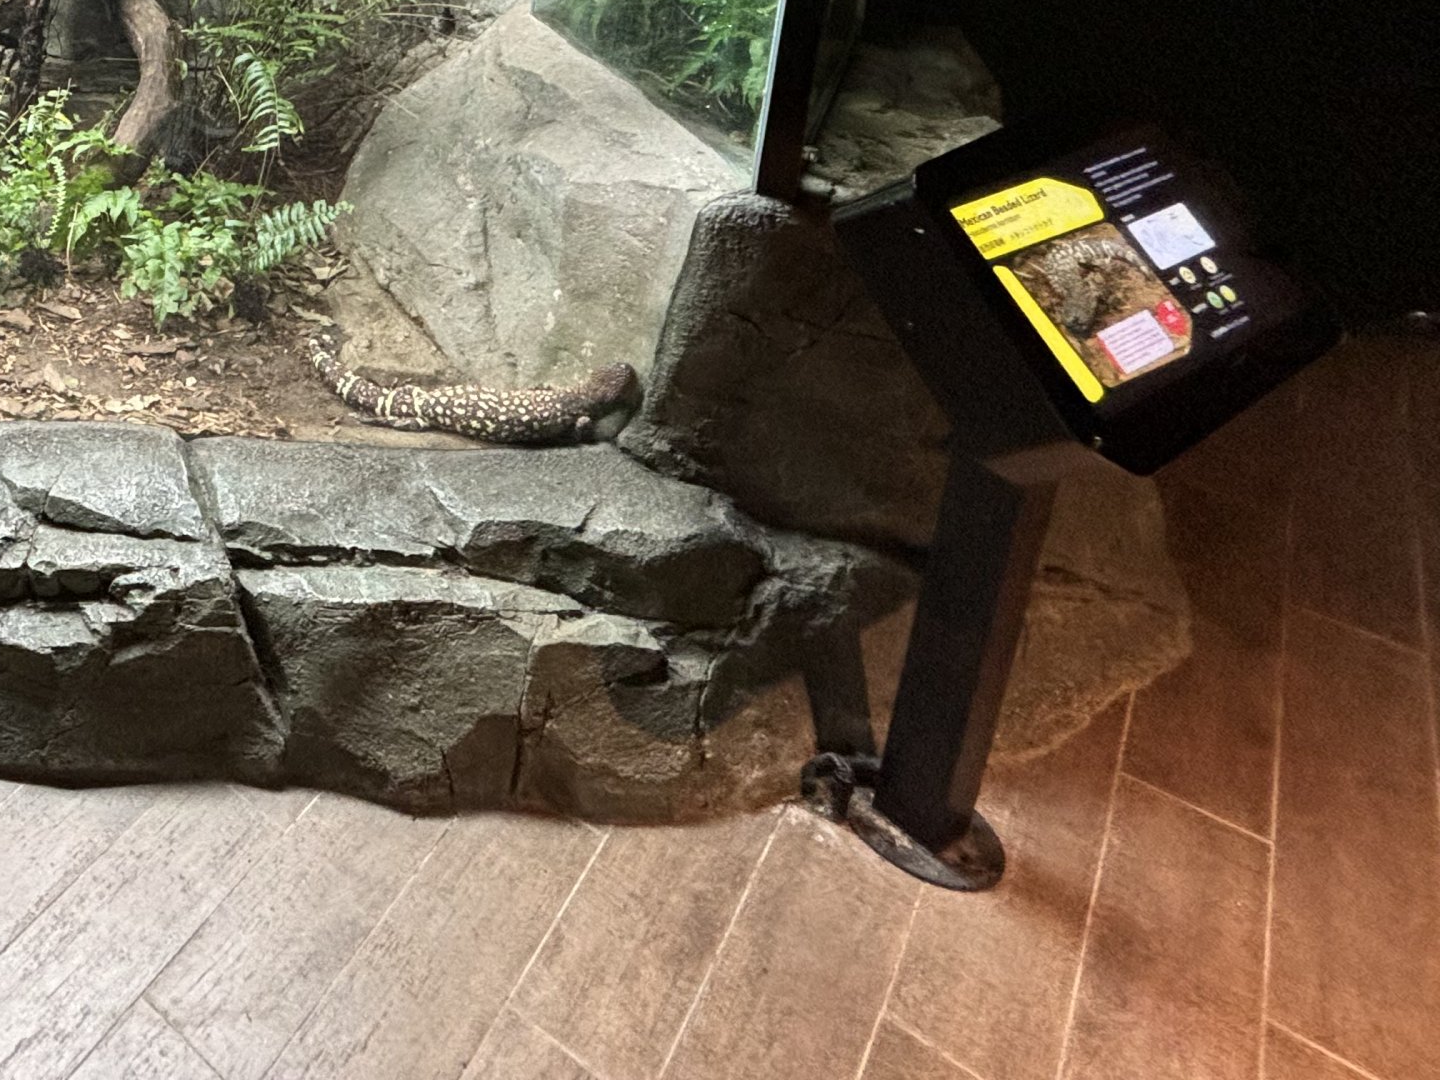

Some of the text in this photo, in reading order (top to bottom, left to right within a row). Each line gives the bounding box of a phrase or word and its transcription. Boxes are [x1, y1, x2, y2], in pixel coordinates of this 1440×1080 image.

[959, 209, 992, 227] Mexican
[990, 197, 1023, 216] Beaded
[1023, 188, 1048, 205] Lizard
